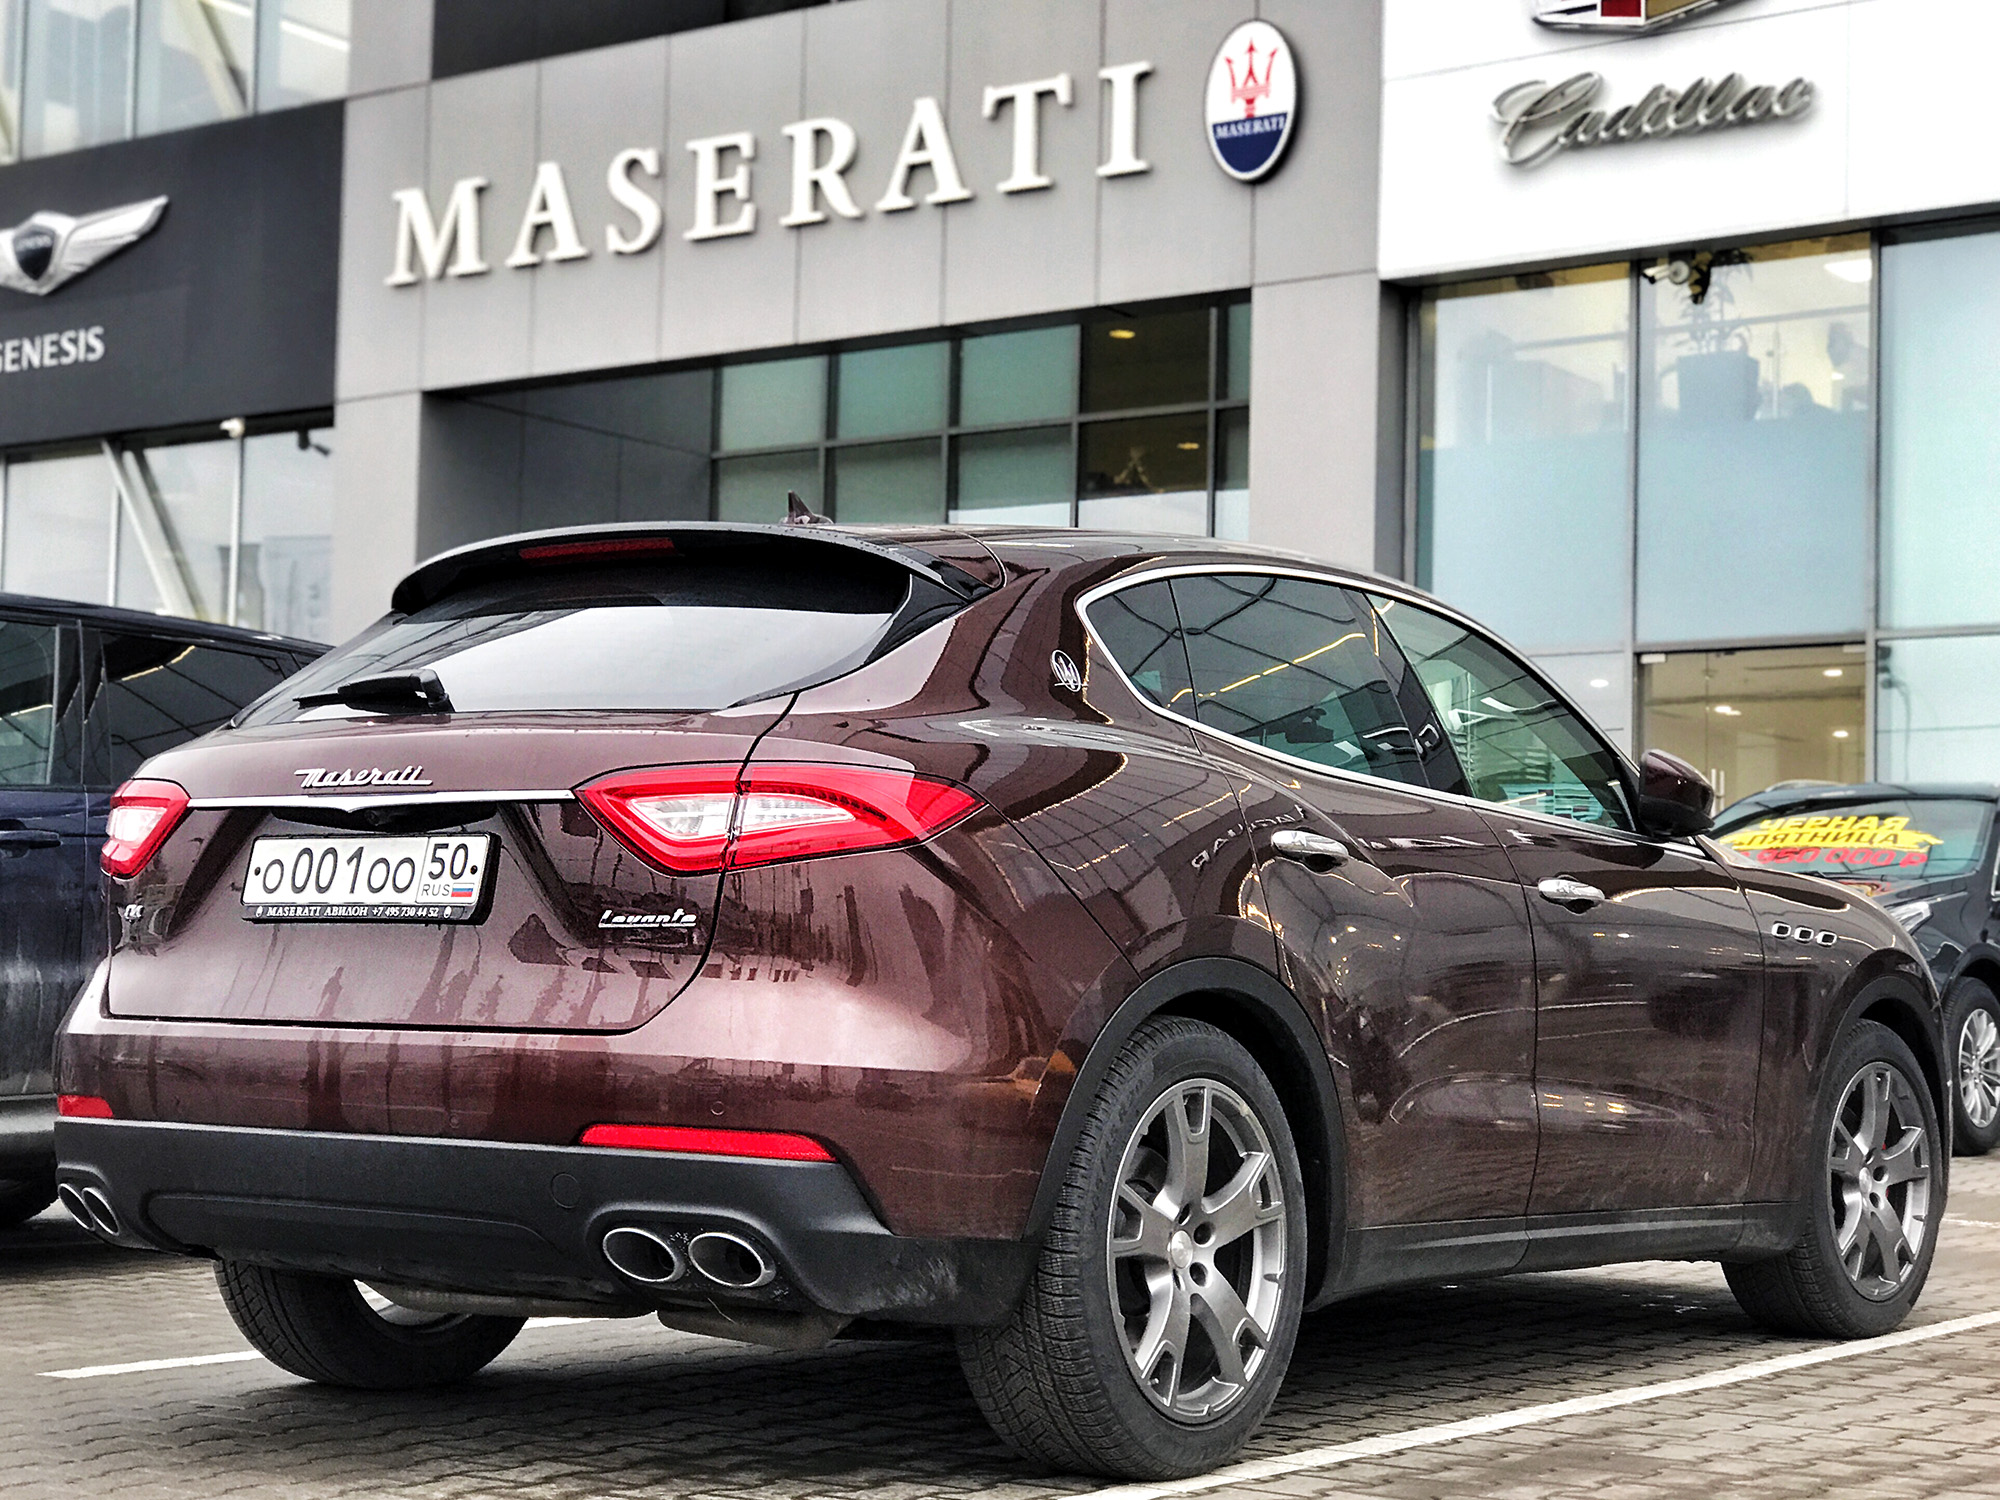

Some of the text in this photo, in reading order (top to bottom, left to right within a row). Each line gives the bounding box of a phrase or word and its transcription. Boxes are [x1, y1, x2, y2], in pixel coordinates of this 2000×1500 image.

[1215, 114, 1285, 140] MASERATI
[1491, 71, 1816, 165] Cadillac
[385, 61, 1153, 285] MASERATI
[0, 325, 105, 373] ENESIS
[294, 765, 433, 788] Maserati
[1759, 815, 1910, 832] ЧЕРНАЯ
[1747, 831, 1899, 846] ПЯТНИЦА
[428, 842, 469, 880] 50
[1824, 848, 1896, 867] 000
[421, 883, 451, 897] RUS
[266, 906, 322, 917] MASERATI
[384, 906, 400, 917] 495
[416, 906, 428, 917] 44
[427, 906, 440, 917] 52
[598, 908, 697, 929] Levante
